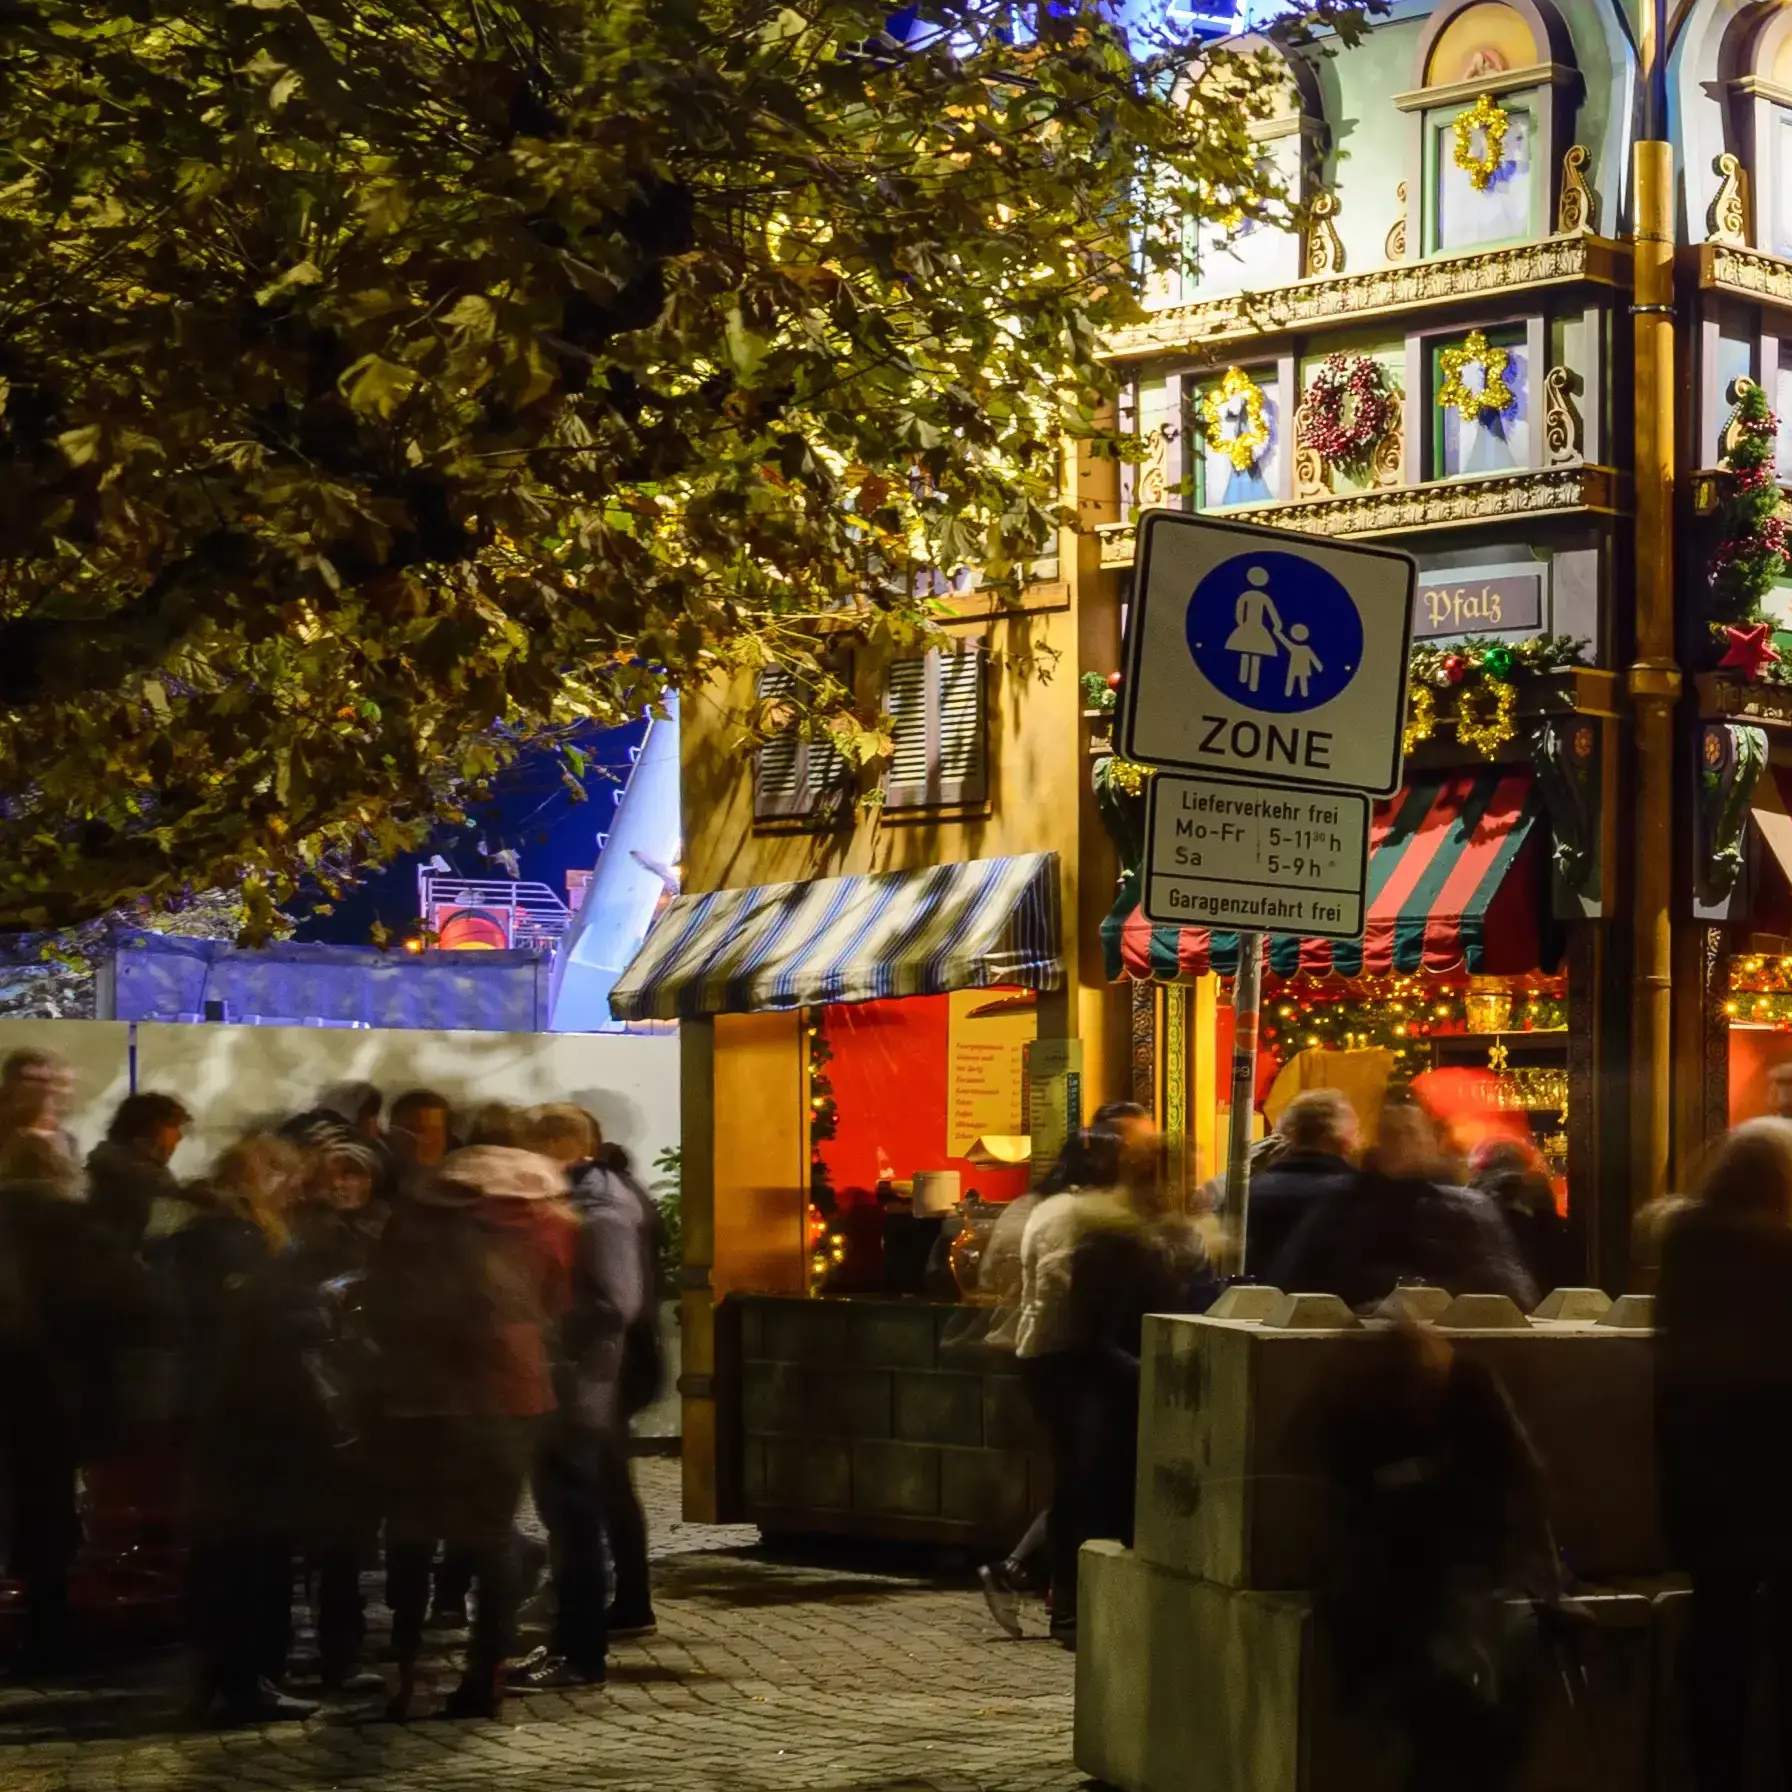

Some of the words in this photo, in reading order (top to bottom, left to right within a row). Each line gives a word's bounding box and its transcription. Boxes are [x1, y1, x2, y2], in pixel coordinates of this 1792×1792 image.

[1424, 586, 1502, 629] Pfalz
[1199, 715, 1333, 769] ZONE
[1182, 791, 1301, 821] Lieferverkehr
[1308, 804, 1338, 825] frei
[1175, 818, 1245, 842] Mo-Fr
[1330, 834, 1341, 852] h
[1175, 846, 1202, 866] Sa
[1268, 855, 1304, 875] 5-9
[1310, 859, 1321, 877] h
[1169, 889, 1303, 918] Garagenzufahrt
[1312, 902, 1341, 922] frei
